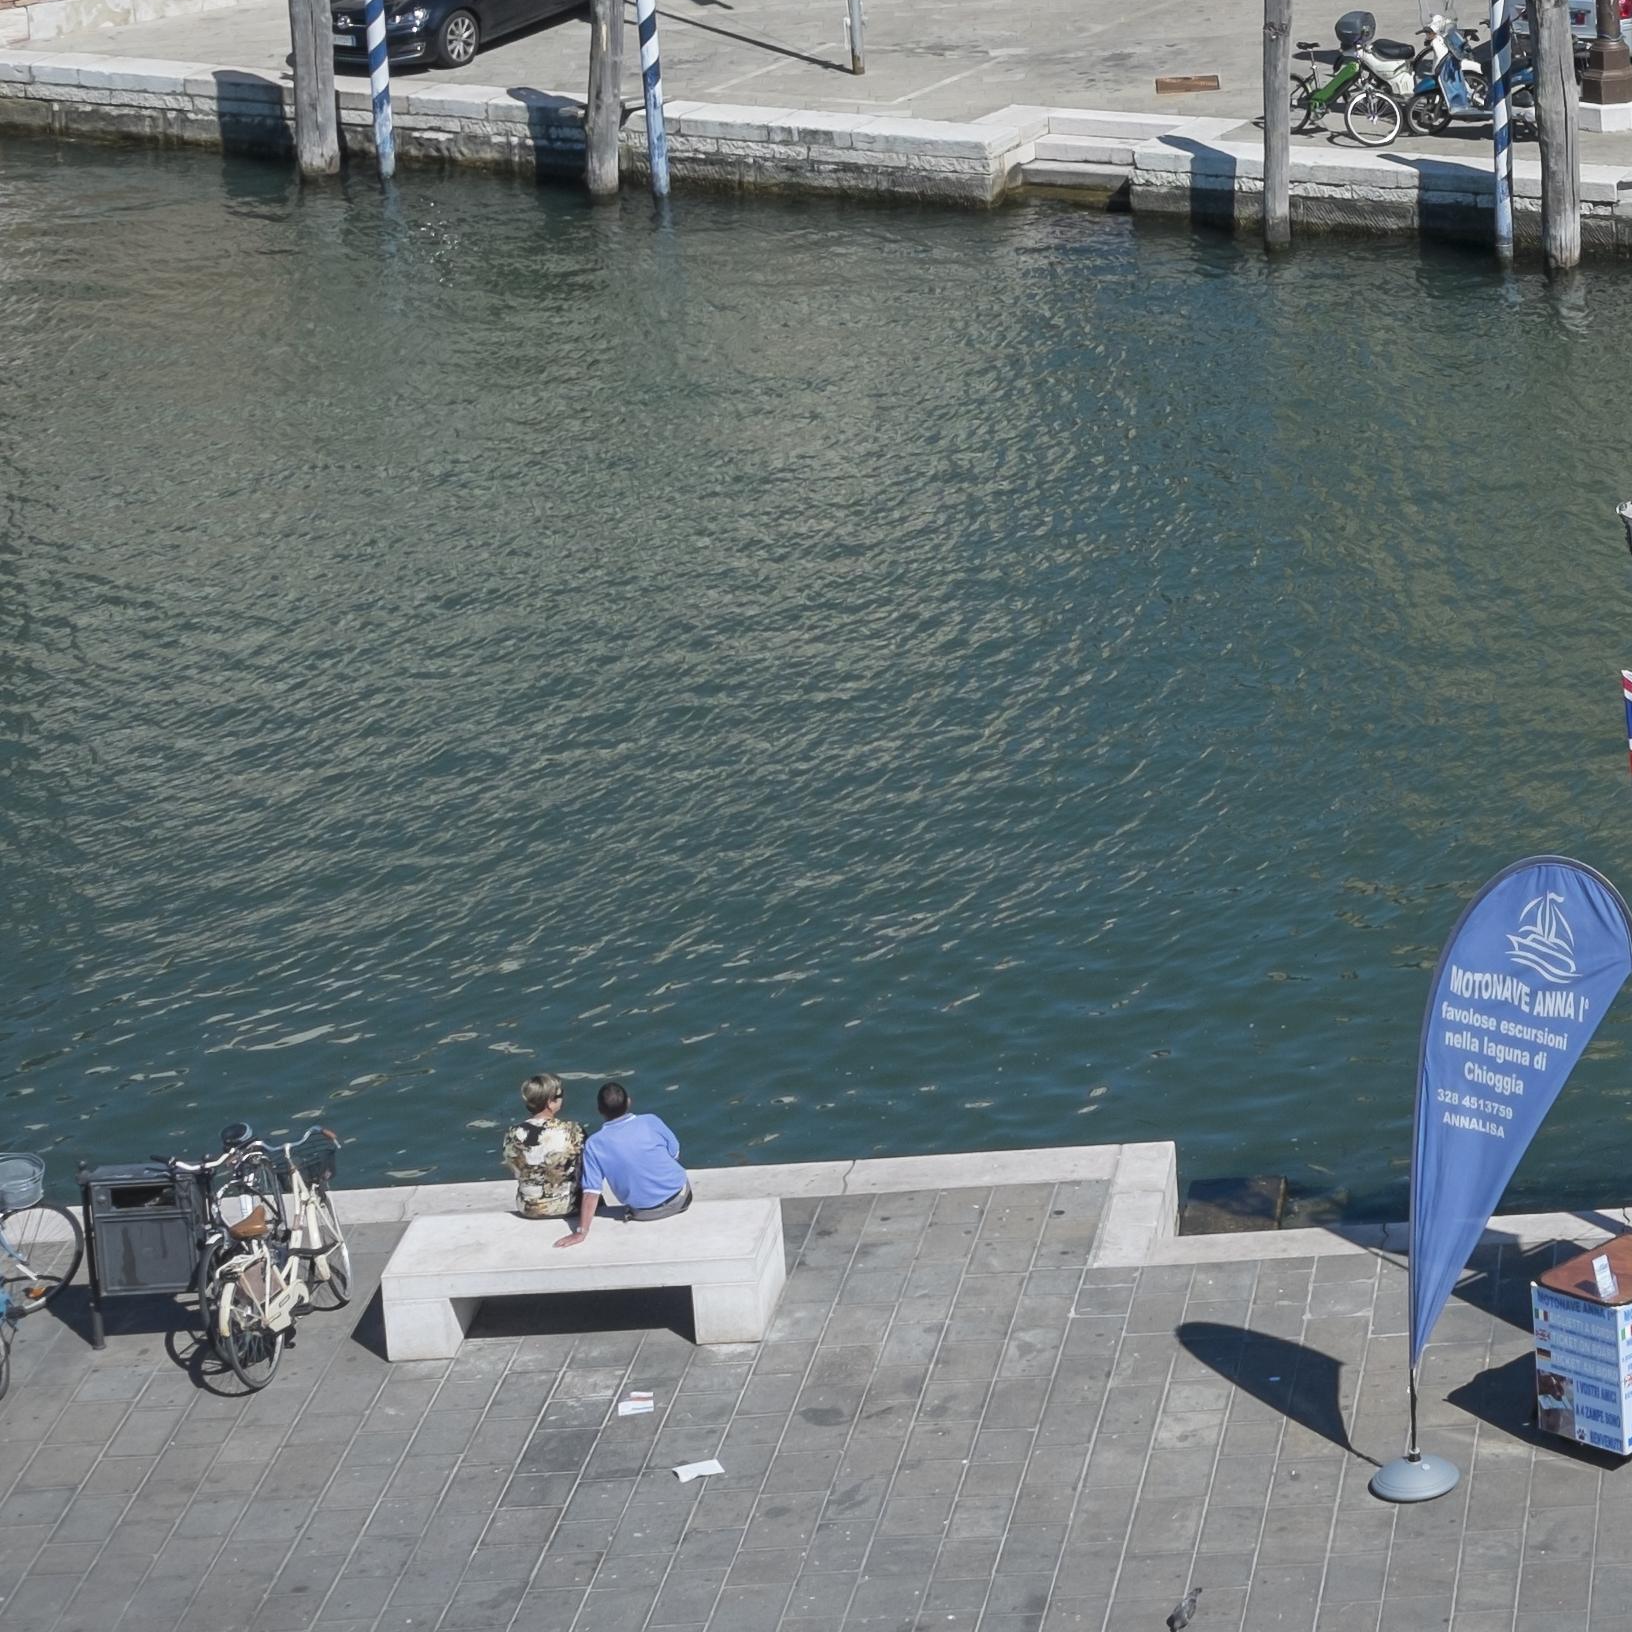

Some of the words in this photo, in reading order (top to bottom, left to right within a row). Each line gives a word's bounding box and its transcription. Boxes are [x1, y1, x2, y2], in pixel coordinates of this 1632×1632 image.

[1450, 965, 1531, 1010] MOTONAVE
[1533, 989, 1575, 1021] ANNA
[1441, 1001, 1497, 1031] favolose
[1500, 1019, 1568, 1051] escursioni
[1445, 1030, 1480, 1053] nella
[1484, 1037, 1531, 1065] laguna
[1534, 1052, 1547, 1071] di
[1464, 1061, 1525, 1096] Chioggia
[1436, 1088, 1460, 1106] 328
[1443, 1111, 1505, 1139] ANNALISA
[1536, 1290, 1581, 1313] MOTONAVE
[1581, 1301, 1606, 1317] ANNA
